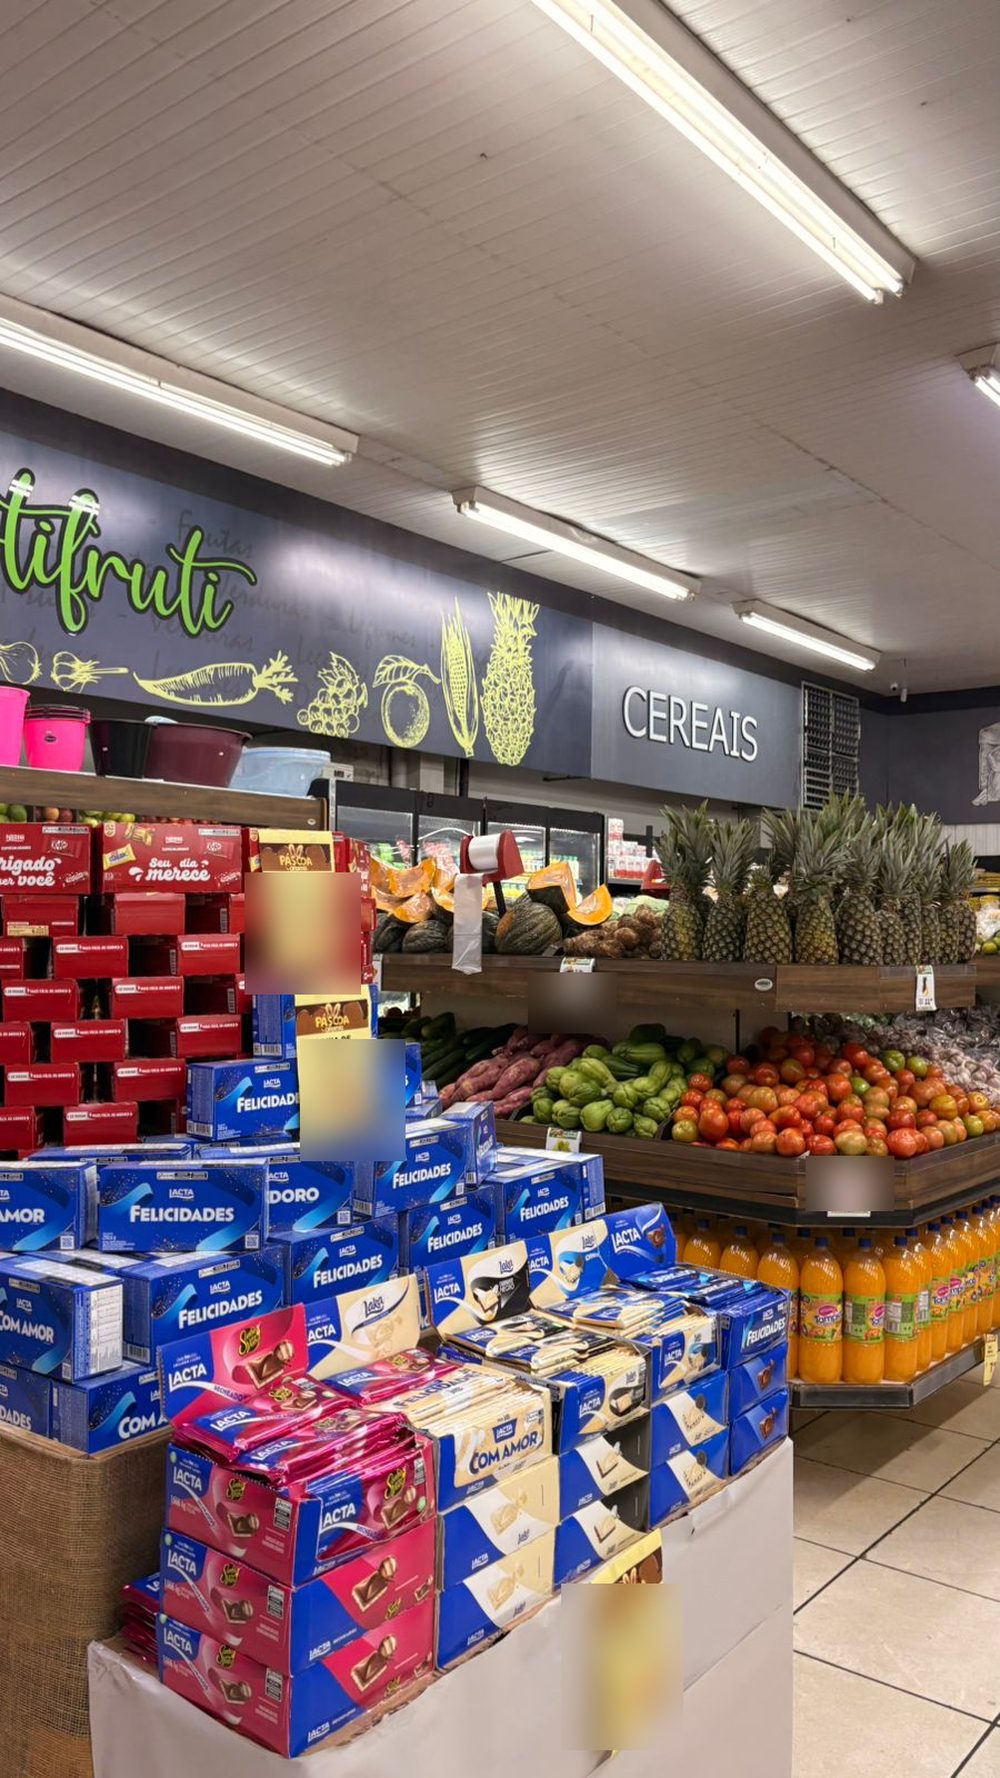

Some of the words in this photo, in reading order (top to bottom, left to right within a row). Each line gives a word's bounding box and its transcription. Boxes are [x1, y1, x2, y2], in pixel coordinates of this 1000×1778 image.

[622, 685, 759, 763] CEREAIS
[149, 857, 172, 868] Seu
[179, 857, 199, 868] dia
[279, 852, 313, 866] PÁSCOA
[17, 871, 56, 887] você
[145, 866, 211, 882] merece
[314, 1012, 350, 1029] PÁSCOA
[237, 1093, 299, 1113] FELICIDAD
[267, 1171, 289, 1182] ACTA
[392, 1162, 451, 1189] FELICIDADES
[169, 1188, 194, 1199] LACTA
[267, 1186, 319, 1205] DORO
[130, 1206, 235, 1223] FELICIDADES
[520, 1196, 569, 1222] FELICIDADES
[427, 1223, 482, 1253] FELICIDADES
[611, 1227, 642, 1254] LACTA
[313, 1254, 383, 1288] FELICIDADES
[209, 1280, 231, 1294] LACTA
[434, 1282, 461, 1304] LACTA
[178, 1289, 263, 1329] FELICIDADES
[22, 1323, 54, 1344] AMOR
[308, 1323, 336, 1342] ACTA
[747, 1317, 786, 1347] FELICIDADES
[168, 1362, 207, 1392] LACTA
[118, 1411, 156, 1440] COM
[209, 1410, 252, 1432] LACTA
[469, 1446, 500, 1474] COM
[502, 1431, 538, 1460] AMOR
[173, 1466, 202, 1492] LACTA
[322, 1502, 356, 1528] ACTA
[167, 1549, 197, 1576] LACTA
[163, 1627, 193, 1655] LACTA
